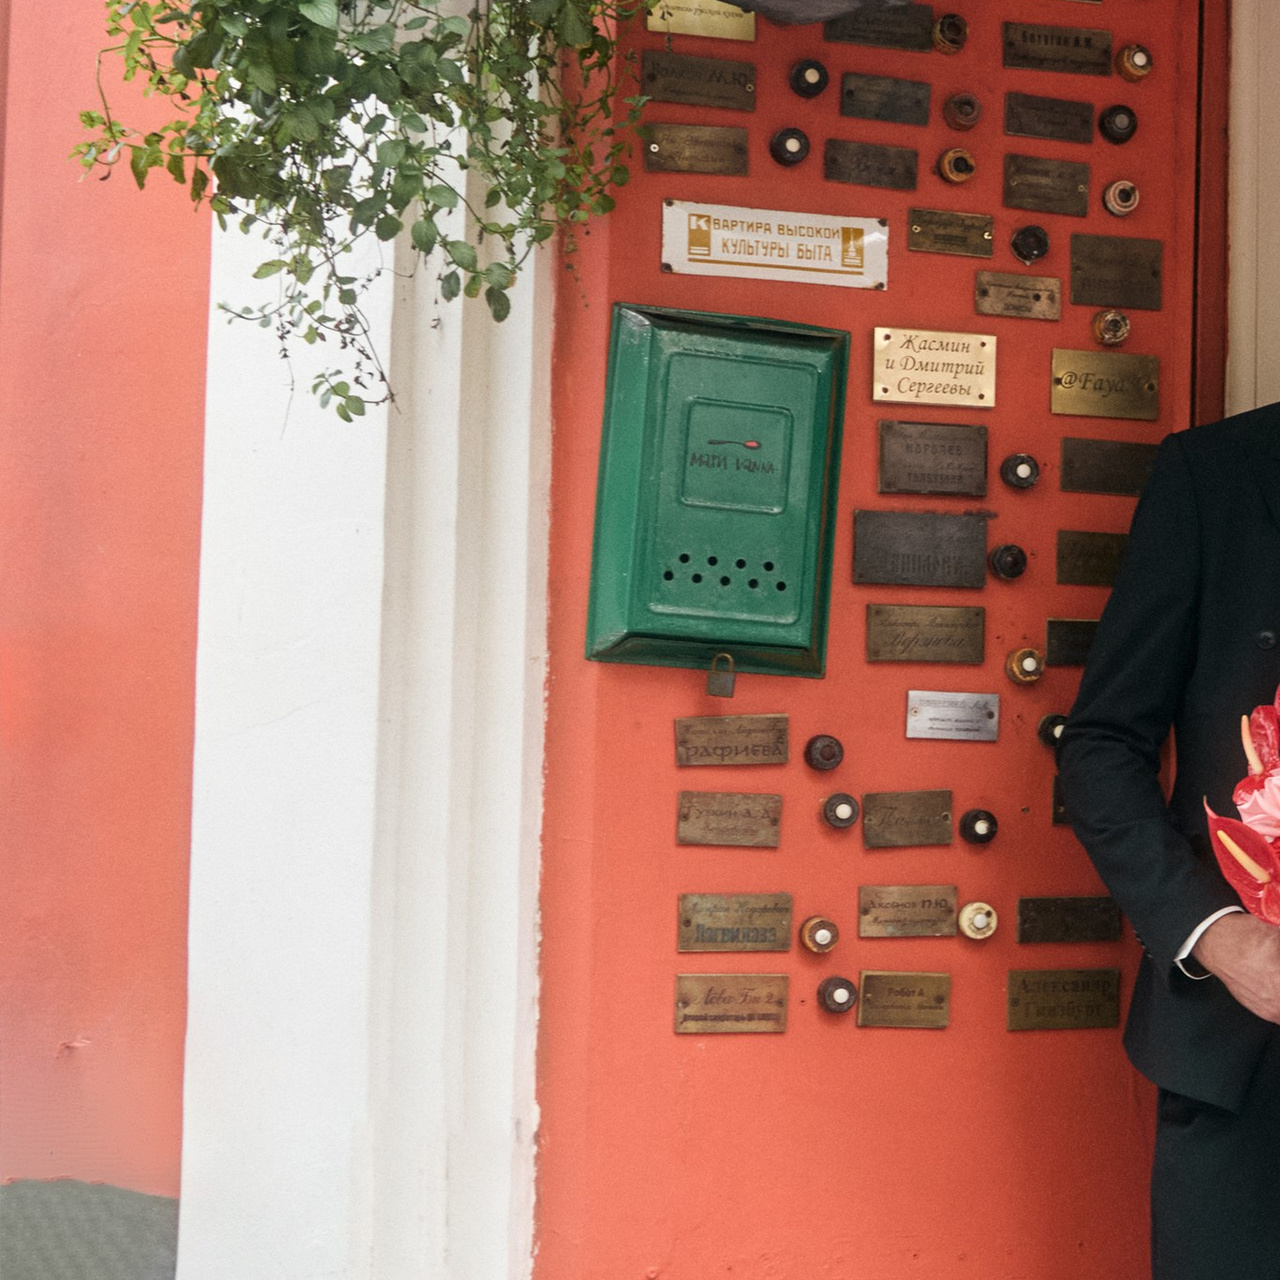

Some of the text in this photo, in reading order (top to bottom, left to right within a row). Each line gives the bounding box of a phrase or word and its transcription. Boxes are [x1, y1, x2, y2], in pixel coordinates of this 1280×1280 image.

[690, 216, 772, 235] КВАРТИРА
[722, 239, 832, 262] КУЛЬТУРЫ БЫТА
[900, 334, 970, 353] Жасмин
[886, 355, 984, 379] и Дмитрий
[897, 377, 971, 398] Сергеевы
